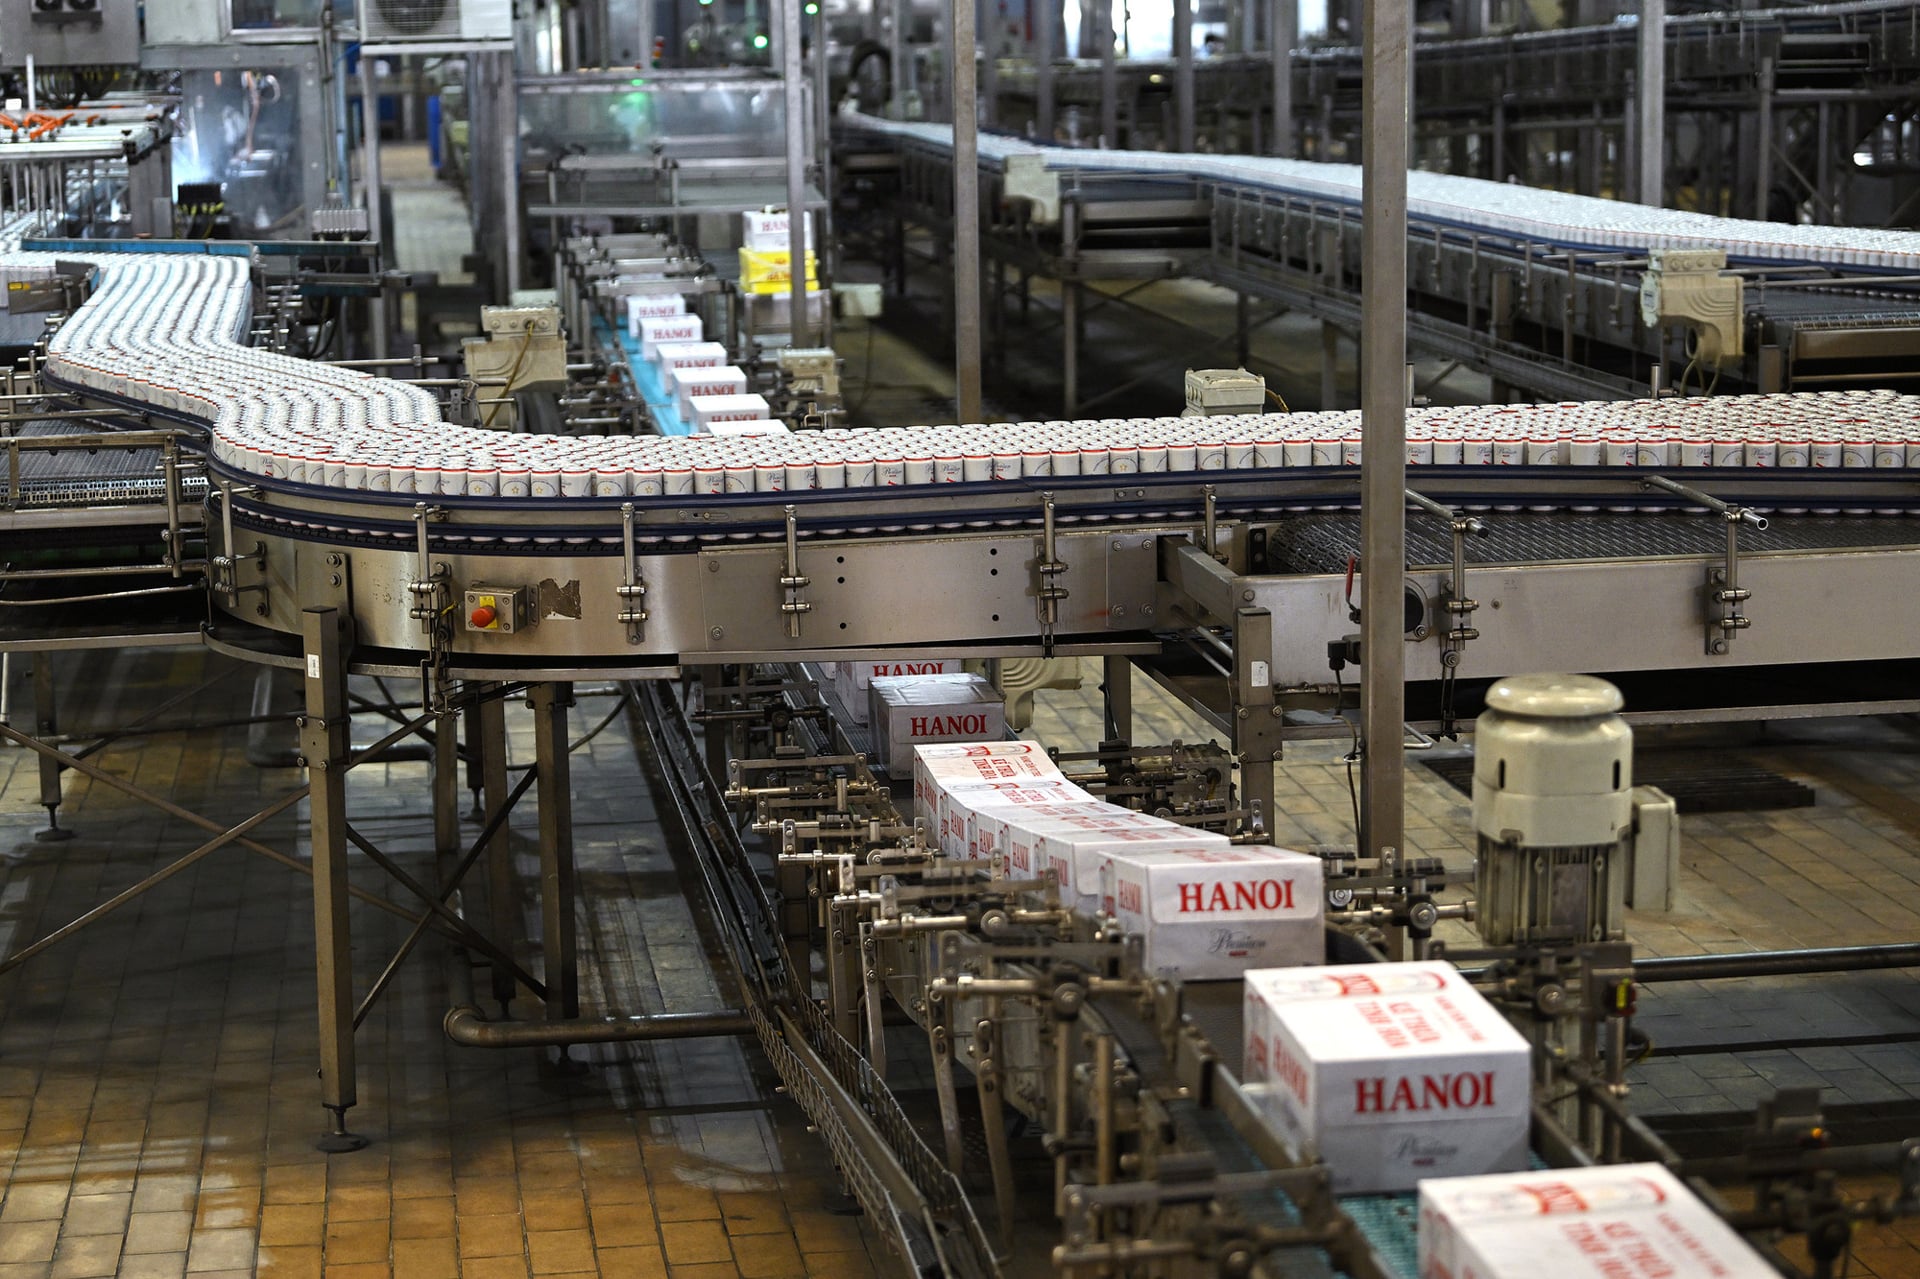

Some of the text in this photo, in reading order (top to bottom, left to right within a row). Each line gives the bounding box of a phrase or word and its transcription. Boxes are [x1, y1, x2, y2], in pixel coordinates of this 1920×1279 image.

[691, 384, 737, 397] HANOI
[873, 662, 944, 677] HANOI
[910, 714, 988, 737] HANOI
[1178, 879, 1296, 913] HANOI
[1354, 1070, 1496, 1115] HANOI
